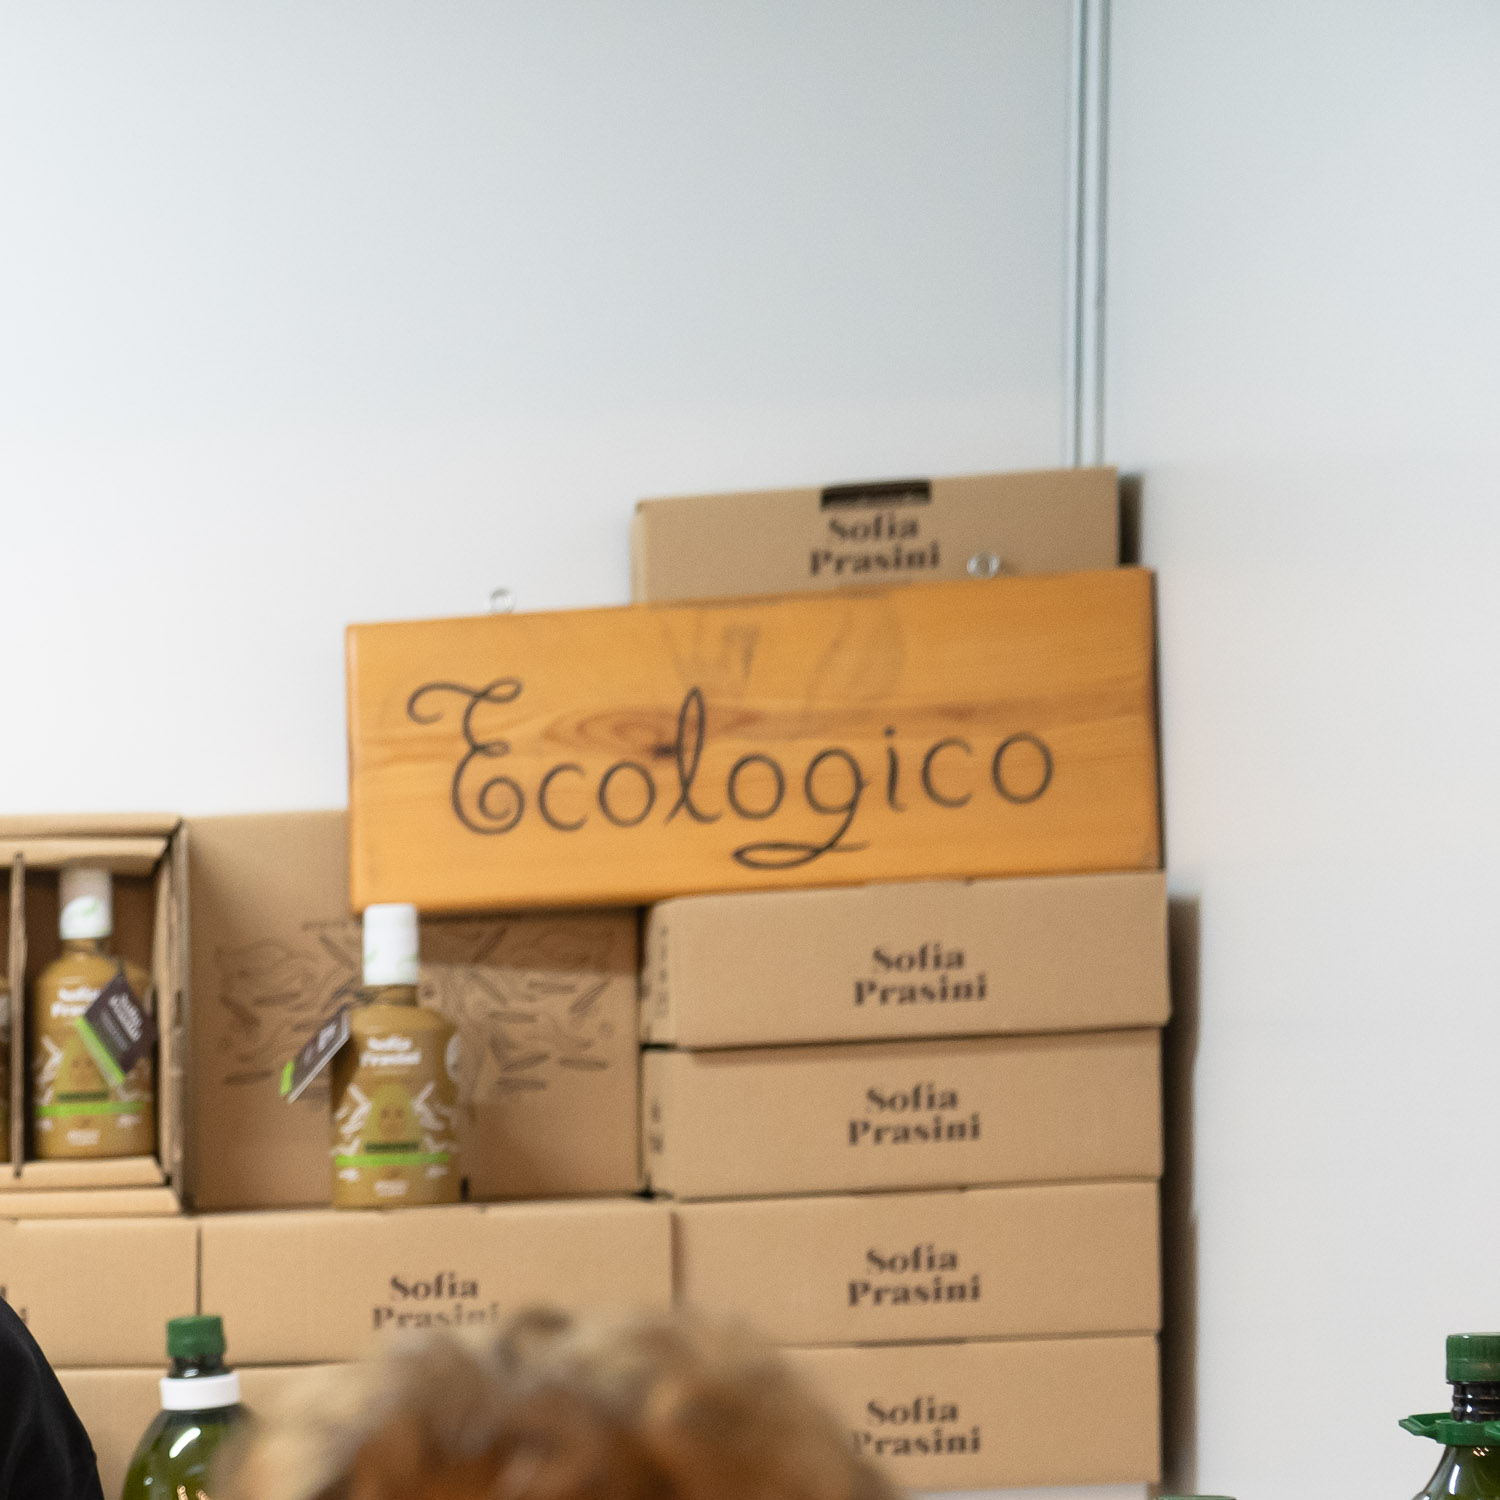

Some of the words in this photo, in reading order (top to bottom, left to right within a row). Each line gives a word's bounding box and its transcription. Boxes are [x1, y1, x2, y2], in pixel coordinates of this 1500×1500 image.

[829, 513, 918, 540] Sofia
[810, 540, 939, 576] Prasini
[405, 676, 1055, 870] Ecologico
[872, 941, 964, 971] Sofia
[854, 972, 987, 1006] Prasini
[866, 1082, 958, 1112] Sofia
[849, 1113, 980, 1145] Prasini
[866, 1244, 958, 1274] Sofia
[390, 1270, 479, 1300] Sofia
[848, 1274, 980, 1307] Prasini
[866, 1396, 959, 1425] Sofia
